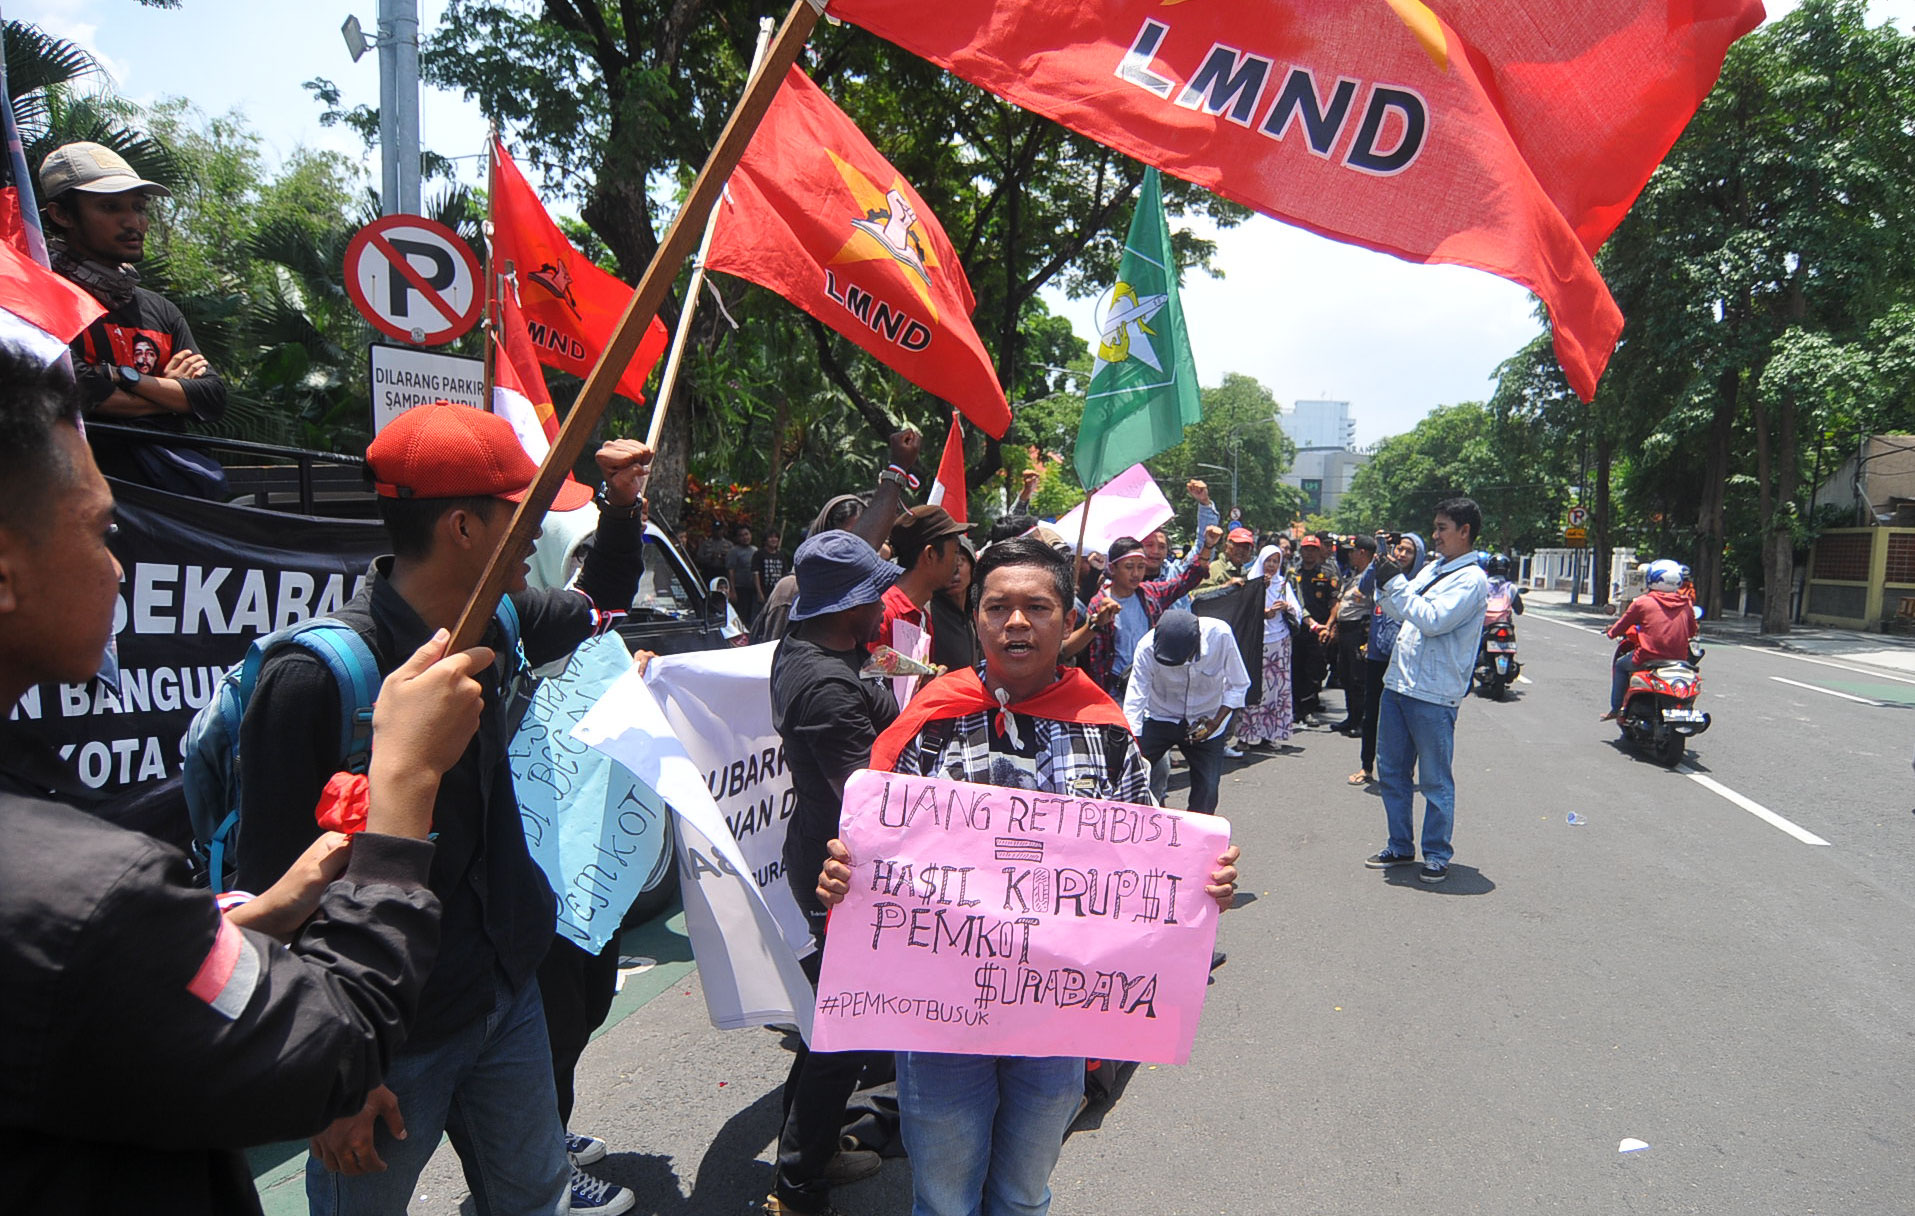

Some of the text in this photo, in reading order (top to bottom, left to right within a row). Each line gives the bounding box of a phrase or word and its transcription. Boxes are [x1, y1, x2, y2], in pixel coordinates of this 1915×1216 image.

[1114, 17, 1430, 177] LMND
[824, 268, 932, 352] LMND
[527, 319, 588, 361] MND
[375, 367, 485, 395] DILARANG PARKIR
[59, 736, 167, 789] OTA
[879, 781, 1184, 847] UANG RETRIBUSI
[870, 901, 1040, 965] PEMKOT
[819, 990, 990, 1027] #PEMKOTBUSUK
